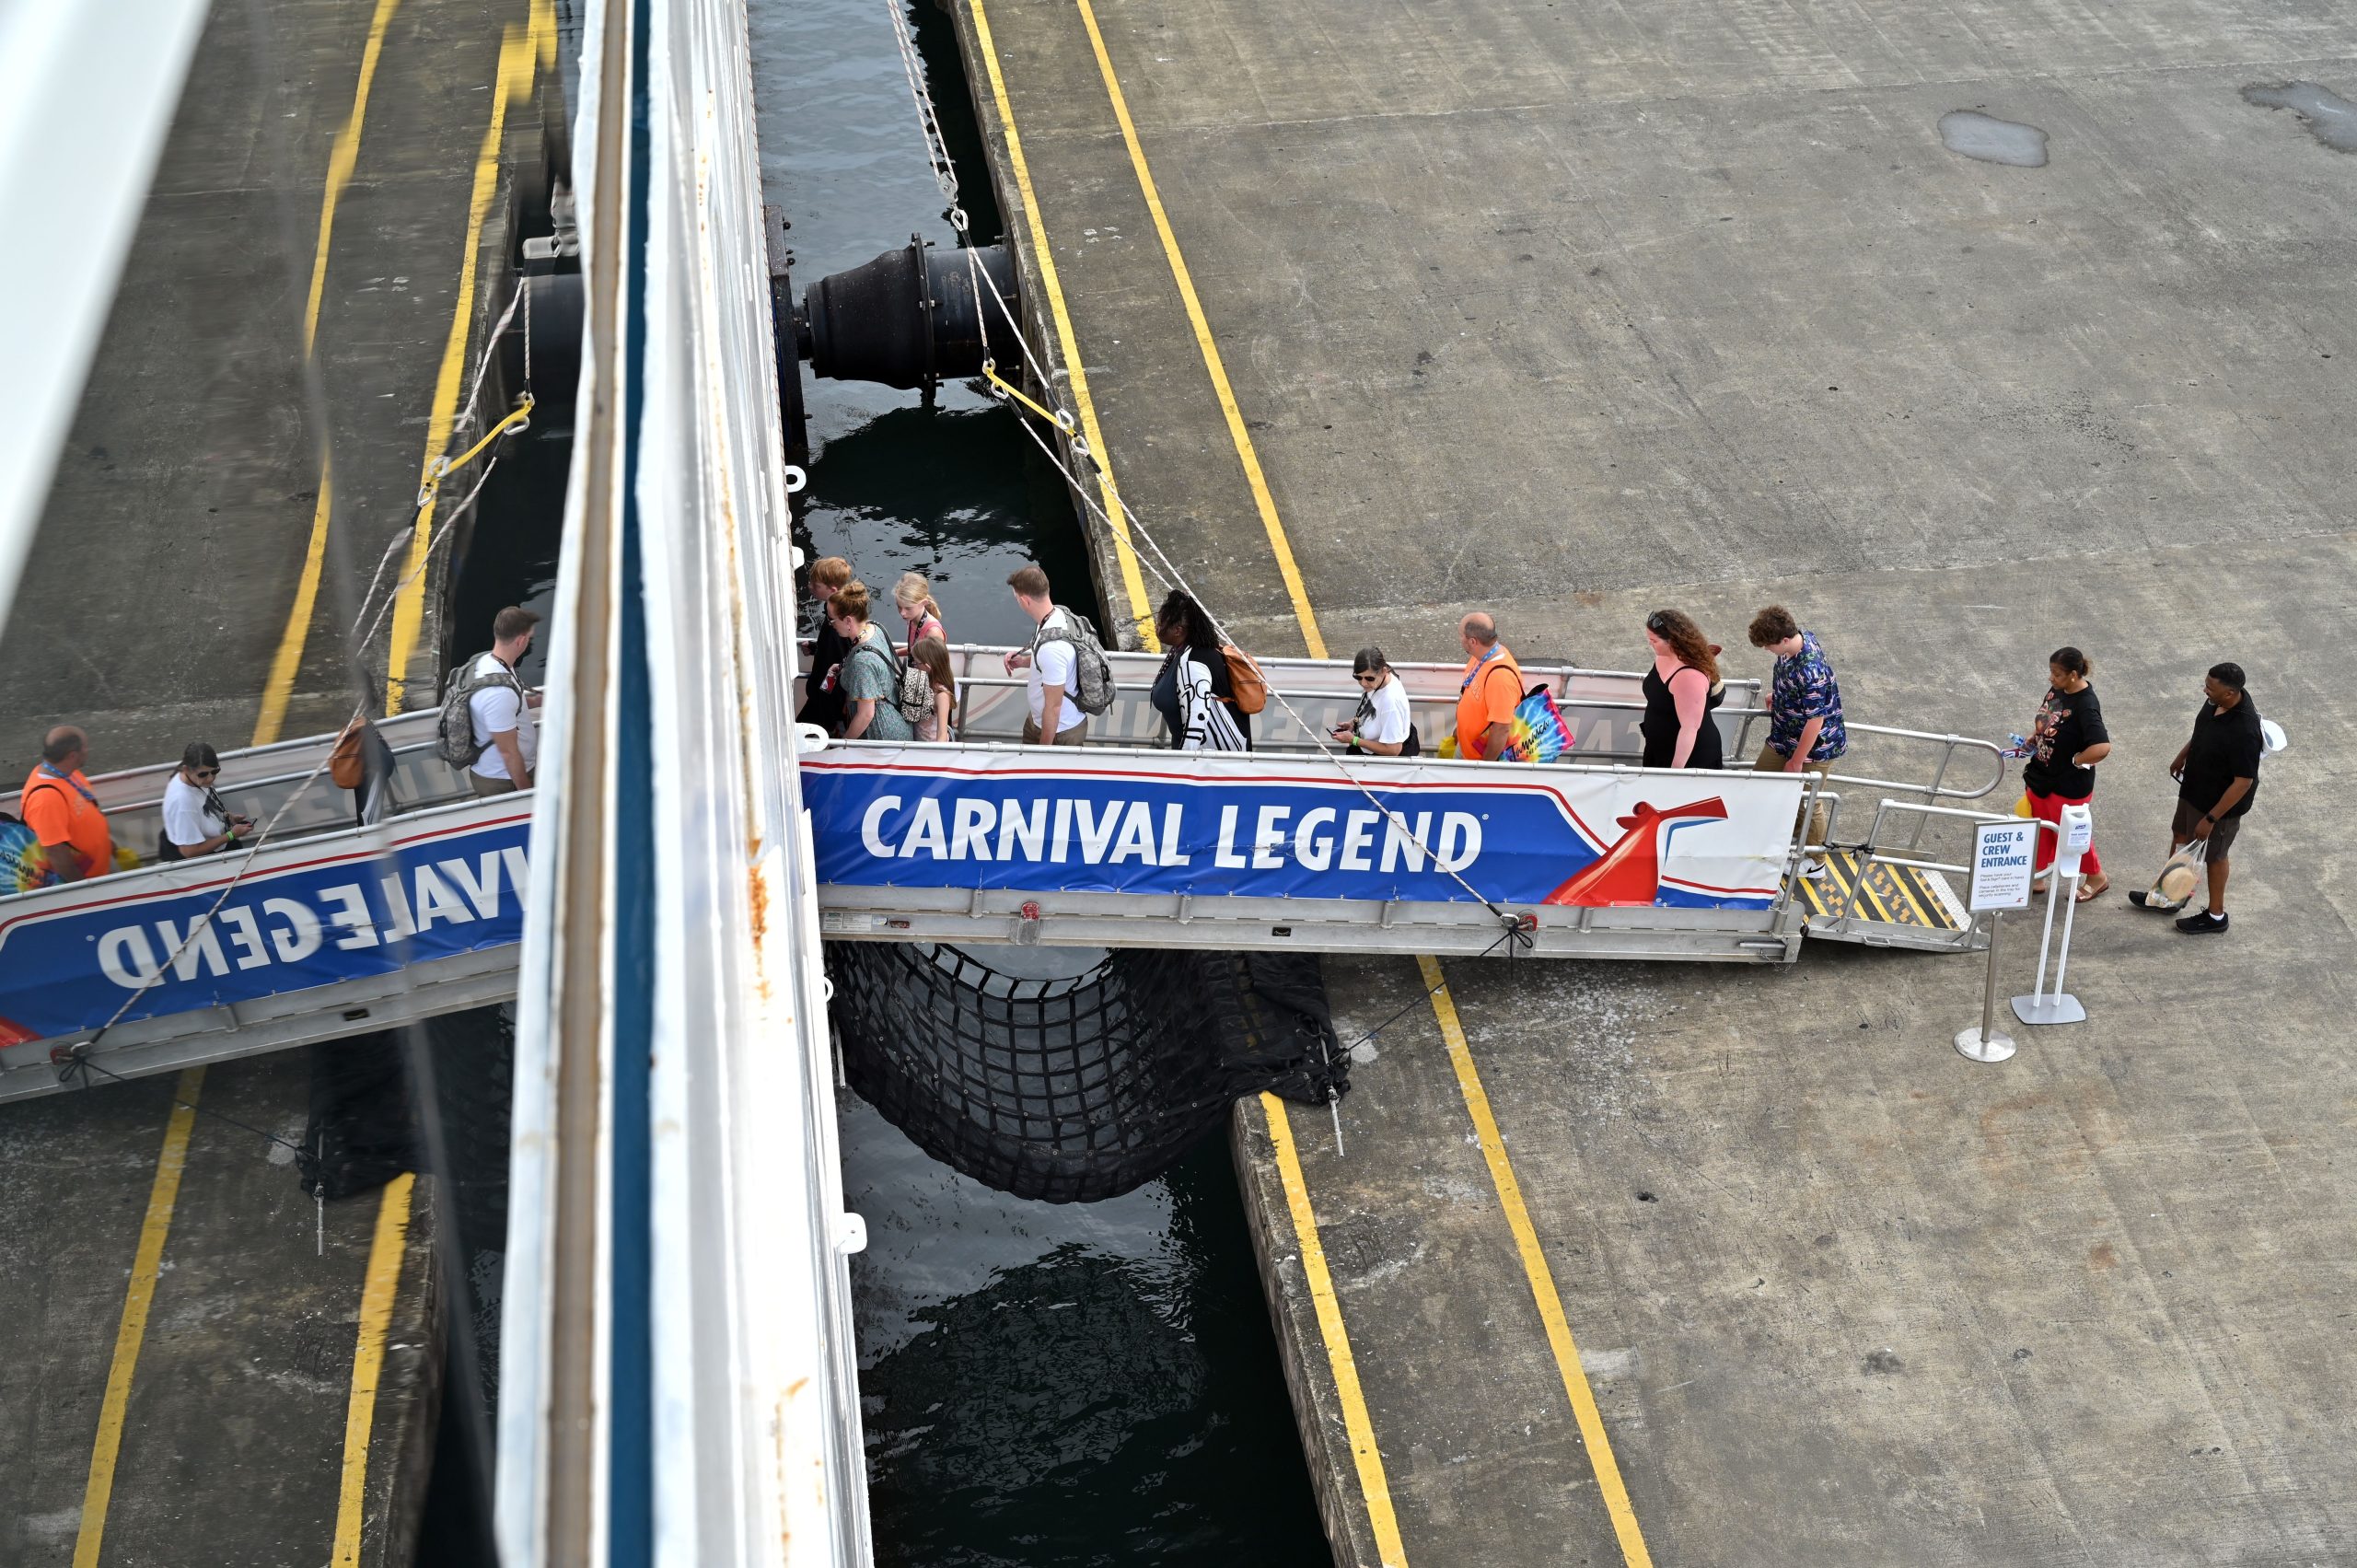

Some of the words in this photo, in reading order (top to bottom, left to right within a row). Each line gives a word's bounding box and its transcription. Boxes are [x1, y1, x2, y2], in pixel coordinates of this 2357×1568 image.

[861, 795, 1190, 867] CARNIVAL
[1983, 831, 2014, 843] GUEST
[2015, 830, 2024, 842] &
[1982, 844, 2011, 856] CREW
[1980, 855, 2027, 868] ENTRANCE
